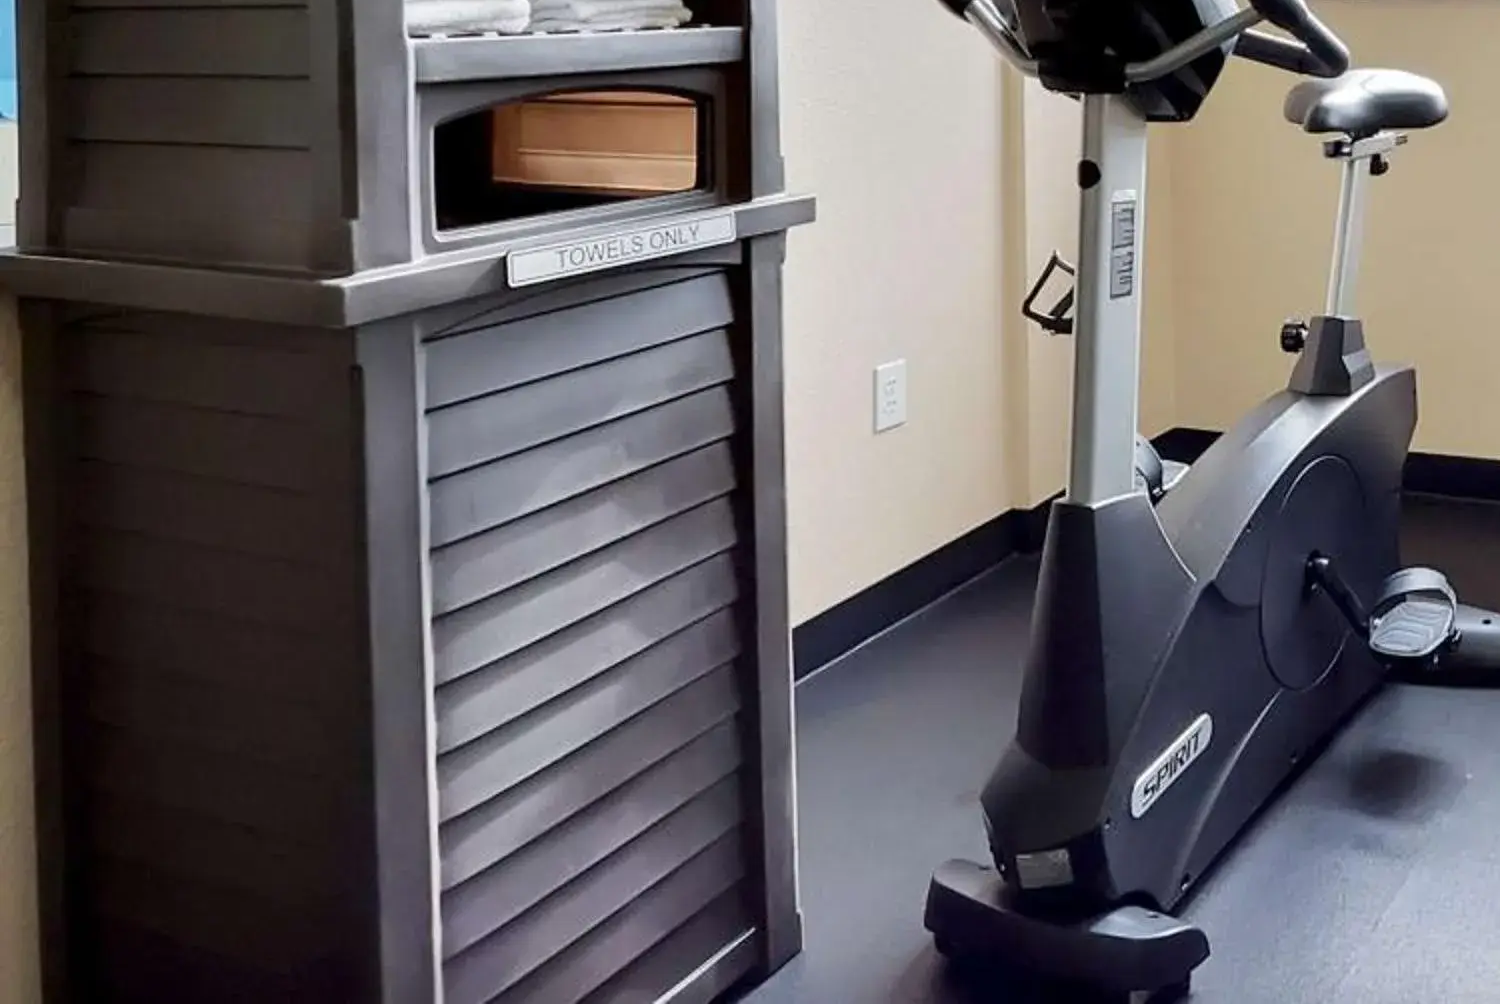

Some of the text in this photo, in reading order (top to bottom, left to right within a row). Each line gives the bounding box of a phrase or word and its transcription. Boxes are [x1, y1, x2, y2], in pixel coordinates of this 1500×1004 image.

[555, 224, 699, 268] TOWELS ONLY
[1138, 725, 1202, 809] SPIRIT
